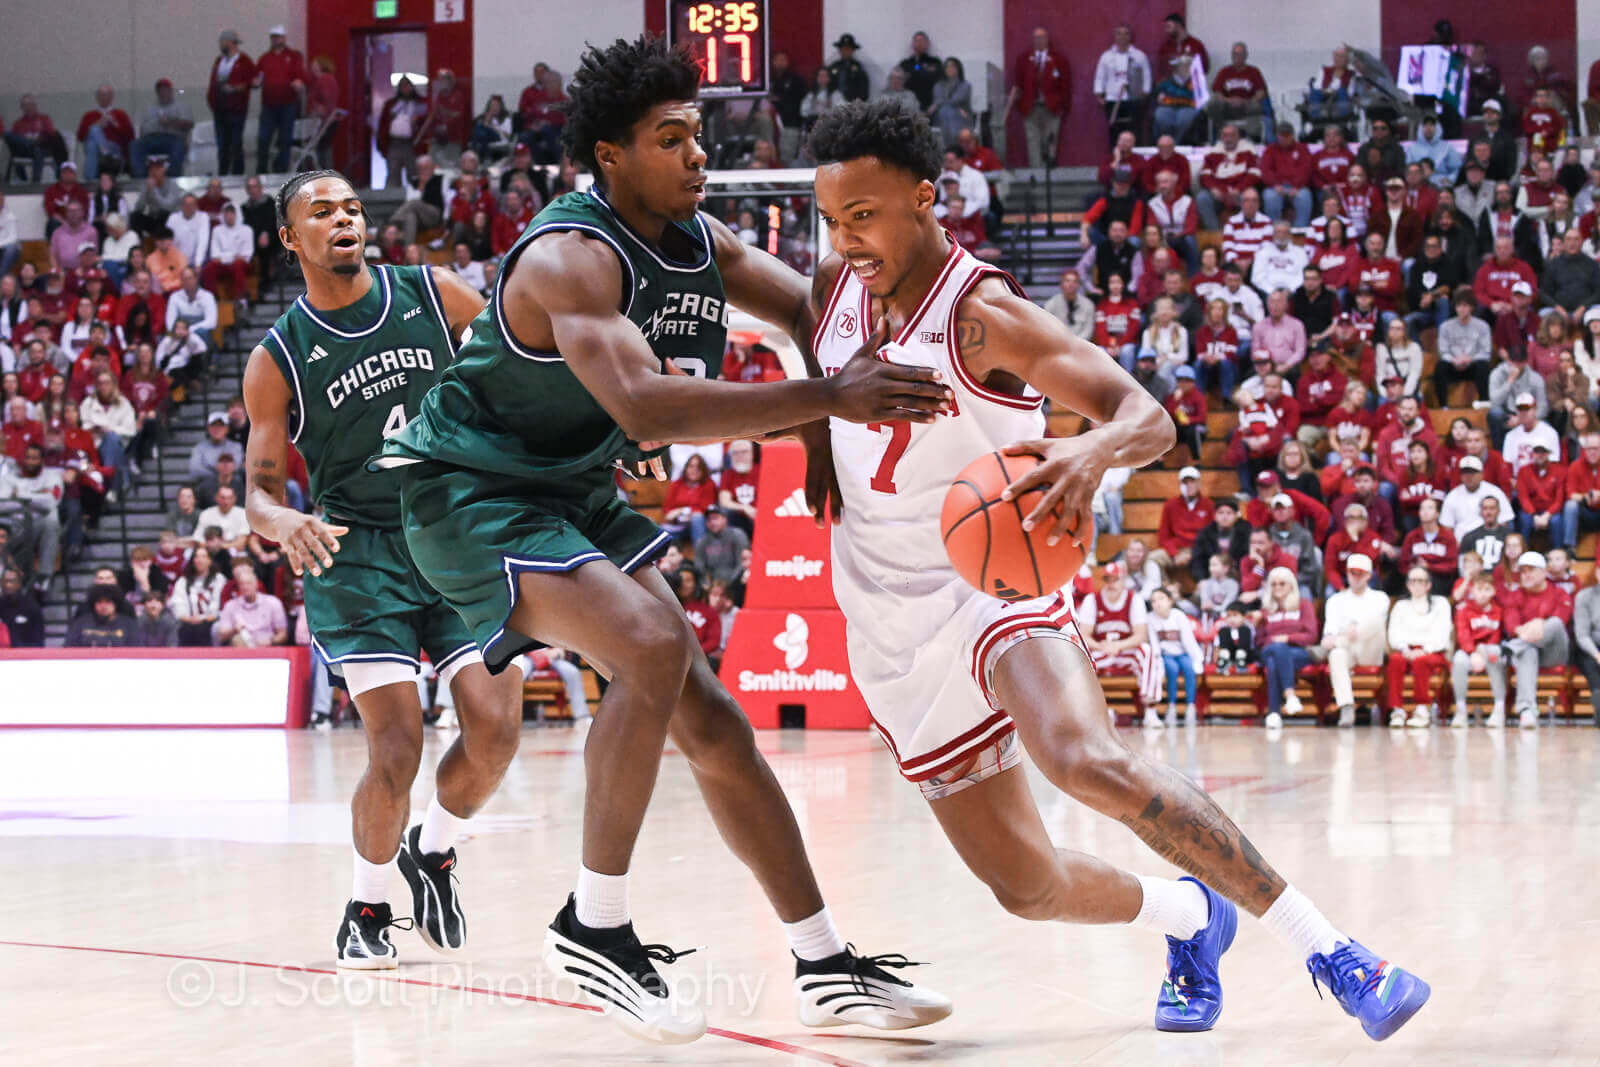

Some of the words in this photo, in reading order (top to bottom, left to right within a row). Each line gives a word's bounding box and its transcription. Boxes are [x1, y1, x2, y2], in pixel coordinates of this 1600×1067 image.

[689, 2, 759, 34] 12:35
[707, 34, 751, 83] 17
[403, 306, 422, 321] NEC
[840, 313, 855, 332] 76
[326, 347, 434, 409] CHICAGO
[361, 371, 408, 401] STATE
[382, 403, 408, 440] 4
[866, 420, 911, 495] 7
[765, 555, 824, 581] meijer
[738, 669, 847, 692] Smithville
